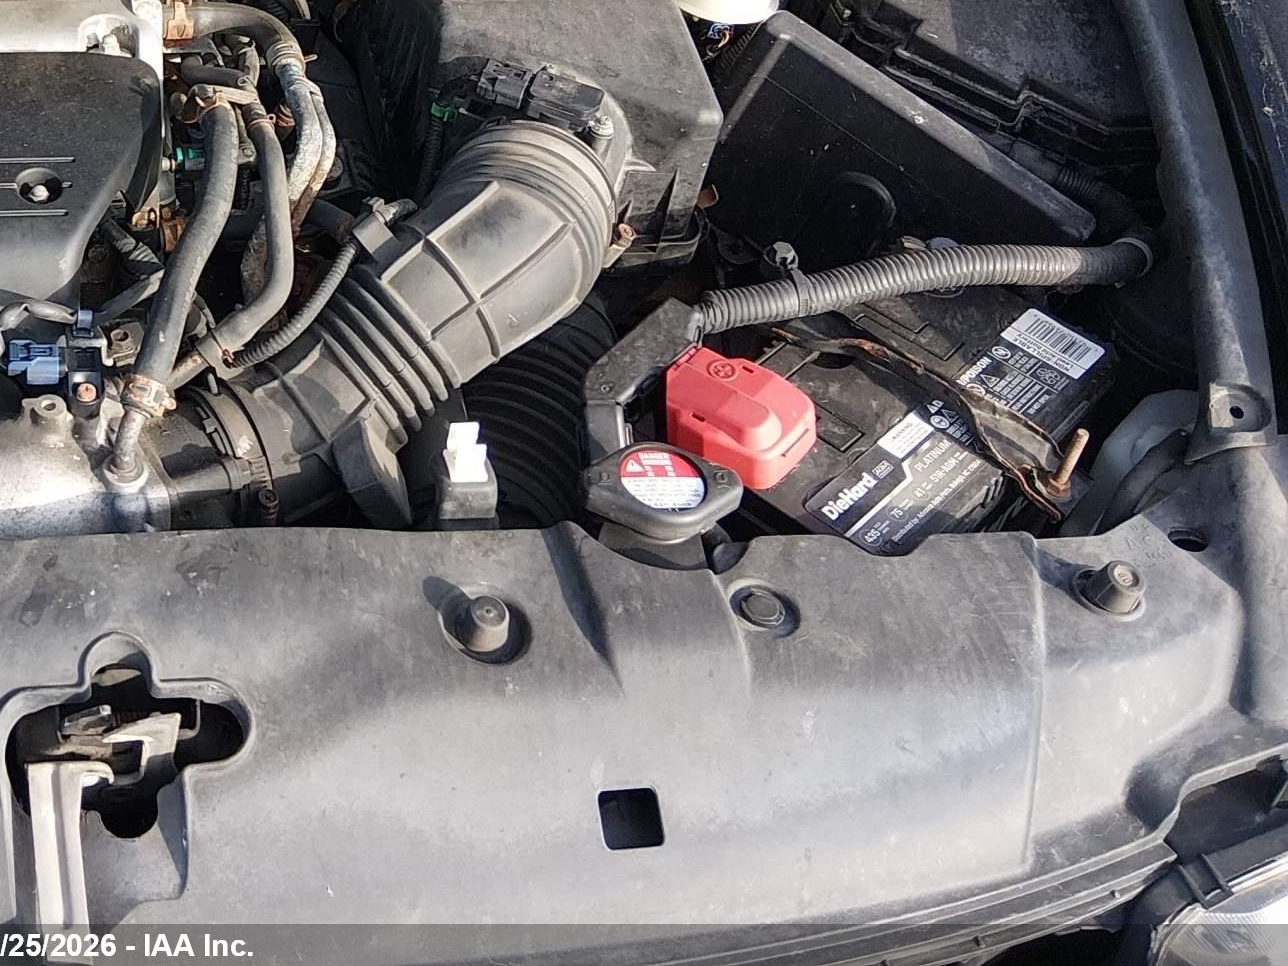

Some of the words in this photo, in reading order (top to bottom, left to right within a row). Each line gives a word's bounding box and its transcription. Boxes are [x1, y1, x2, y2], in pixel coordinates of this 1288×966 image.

[914, 439, 952, 472] PLATINUM
[821, 472, 878, 520] DieHard
[890, 508, 904, 519] 75
[864, 528, 881, 543] 435
